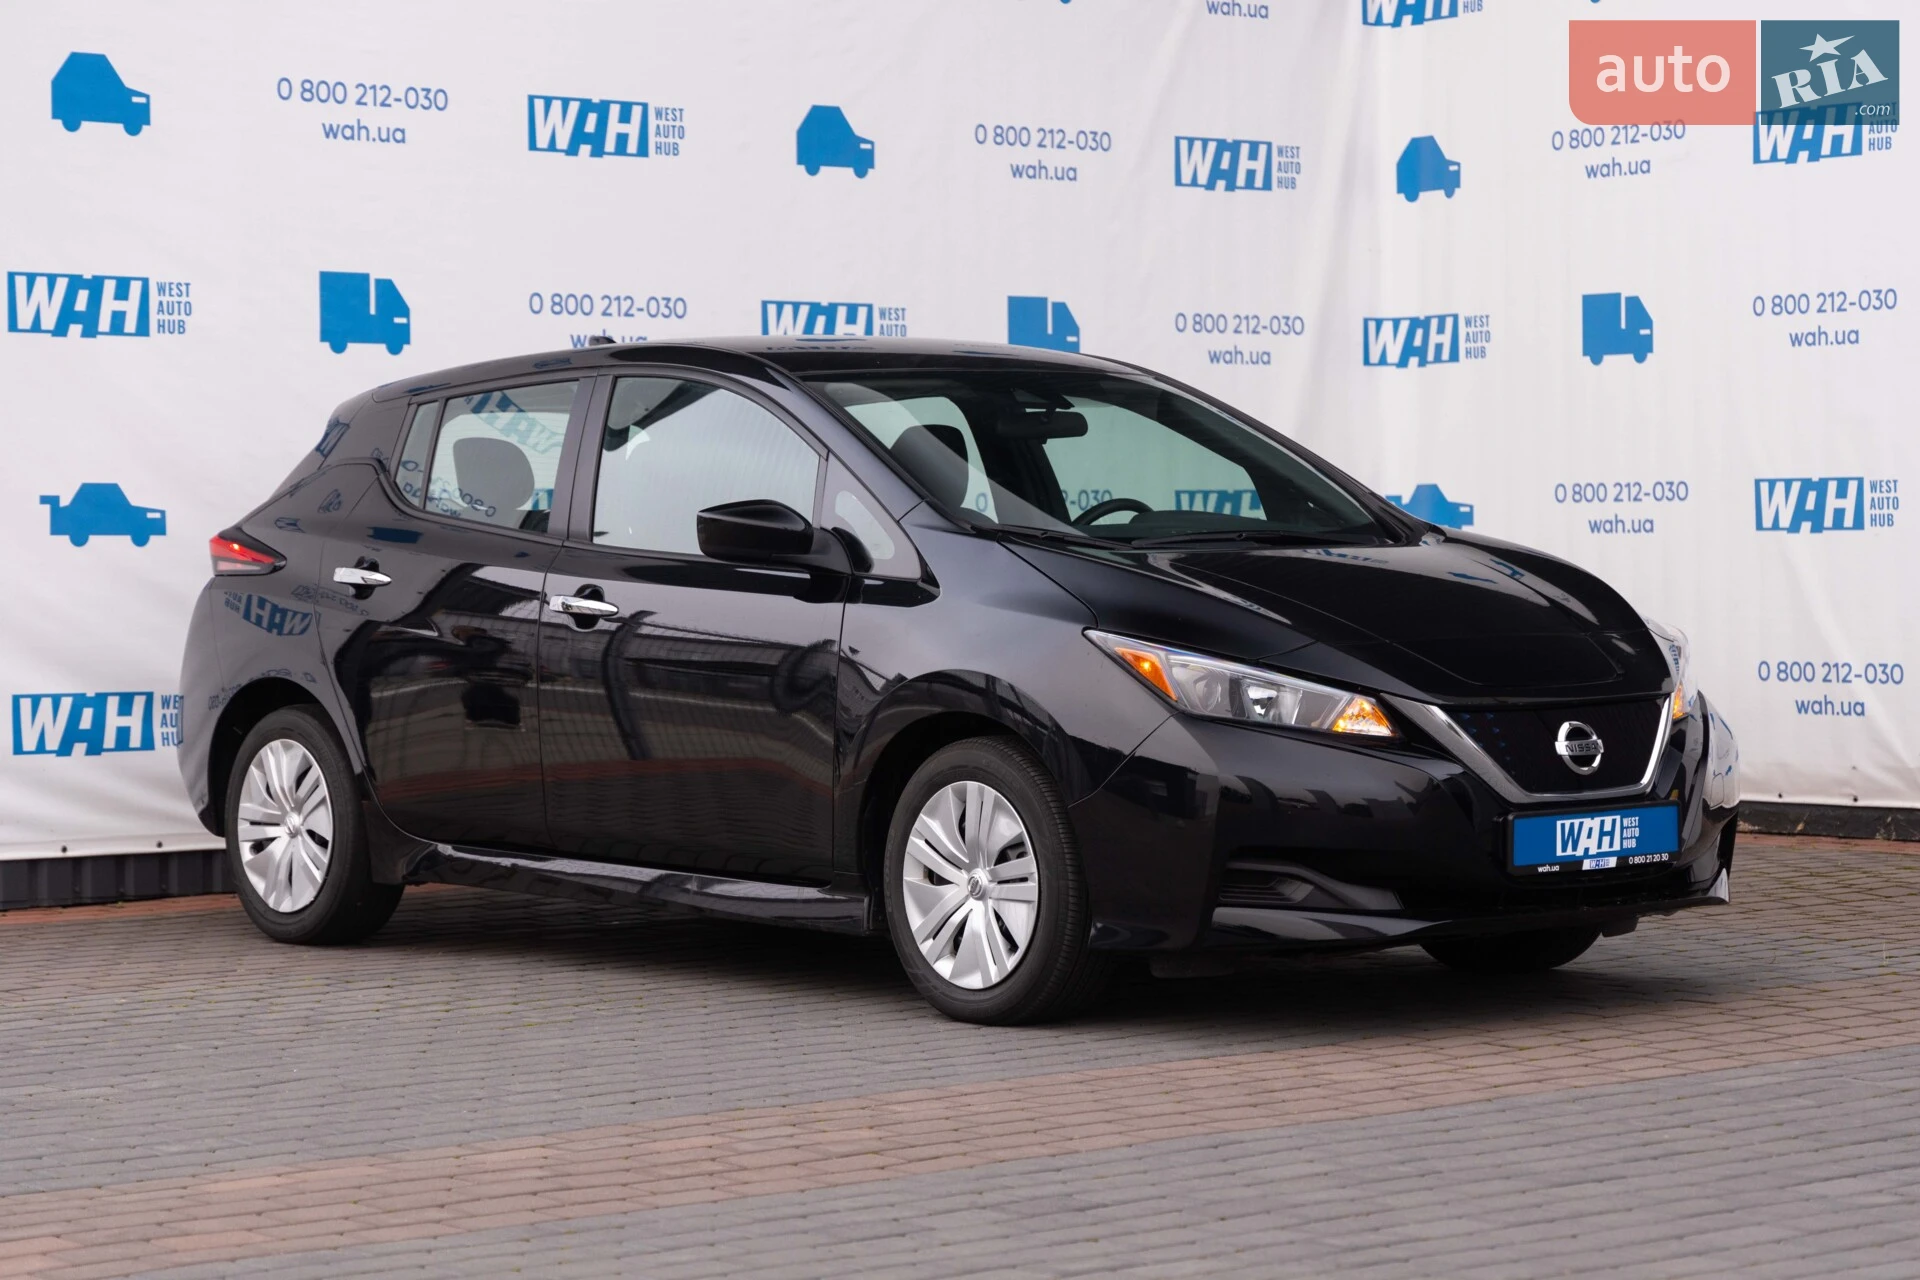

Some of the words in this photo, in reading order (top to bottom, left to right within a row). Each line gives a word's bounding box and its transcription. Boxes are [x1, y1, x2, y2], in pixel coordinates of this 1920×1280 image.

[1206, 0, 1269, 19] wah.ua
[1463, 0, 1483, 13] HUB
[277, 77, 293, 102] 0
[300, 79, 348, 106] 800
[355, 82, 449, 111] 212-030
[654, 106, 684, 122] WEST
[322, 118, 406, 144] wah.ua
[528, 94, 649, 158] WAH
[655, 124, 685, 140] AUTO
[1753, 102, 1863, 164] WAH
[975, 124, 987, 145] 0
[992, 125, 1031, 149] 800
[1037, 127, 1112, 152] 212-030
[1552, 130, 1564, 151] 0
[1569, 126, 1605, 149] 800
[1611, 118, 1686, 145] 212-030
[655, 141, 680, 157] HUB
[1276, 145, 1300, 158] WEST
[1868, 136, 1892, 151] HUB
[1010, 159, 1077, 182] wah.ua
[1175, 136, 1272, 191] WAH
[1276, 160, 1301, 175] AUTO
[1585, 157, 1651, 179] wah.ua
[1277, 176, 1297, 190] HUB
[156, 281, 191, 298] WEST
[7, 271, 150, 338] WAH
[156, 300, 192, 317] AUTO
[529, 292, 543, 315] 0
[550, 293, 594, 316] 800
[601, 294, 687, 319] 212-030
[1753, 296, 1765, 317] 0
[1771, 293, 1810, 316] 800
[1816, 288, 1897, 313] 212-030
[878, 307, 906, 321] WEST
[1464, 314, 1490, 328] WEST
[157, 319, 186, 335] HUB
[878, 324, 907, 337] AUTO
[1175, 312, 1187, 334] 0
[1192, 313, 1228, 335] 800
[1233, 314, 1304, 336] 212-030
[1363, 314, 1459, 368] WAH
[1465, 330, 1491, 344] AUTO
[1789, 325, 1860, 348] wah.ua
[1208, 346, 1271, 367] wah.ua
[1465, 346, 1487, 360] HUB
[1554, 482, 1567, 503] 0
[1572, 482, 1608, 503] 800
[1613, 480, 1689, 504] 212-030
[1870, 479, 1898, 494] WEST
[1755, 476, 1864, 533] WAH
[1870, 496, 1899, 511] AUTO
[1588, 513, 1655, 535] wah.ua
[1870, 513, 1894, 528] HUB
[1757, 660, 1771, 682] 0
[1776, 661, 1816, 684] 800
[1821, 661, 1904, 686] 212-030
[160, 695, 179, 710] WE
[1795, 694, 1866, 718] wah.ua
[12, 691, 155, 757] WAH
[160, 713, 179, 728] AU
[160, 732, 179, 747] HU
[1565, 742, 1600, 752] NISSA
[1623, 817, 1639, 827] WEST
[1556, 815, 1621, 856] WAH
[1623, 828, 1639, 838] AUTO
[1623, 838, 1637, 848] HUB
[1634, 856, 1646, 864] 800
[1653, 854, 1661, 862] 20
[1661, 853, 1669, 861] 30
[1537, 864, 1560, 873] wah.ua
